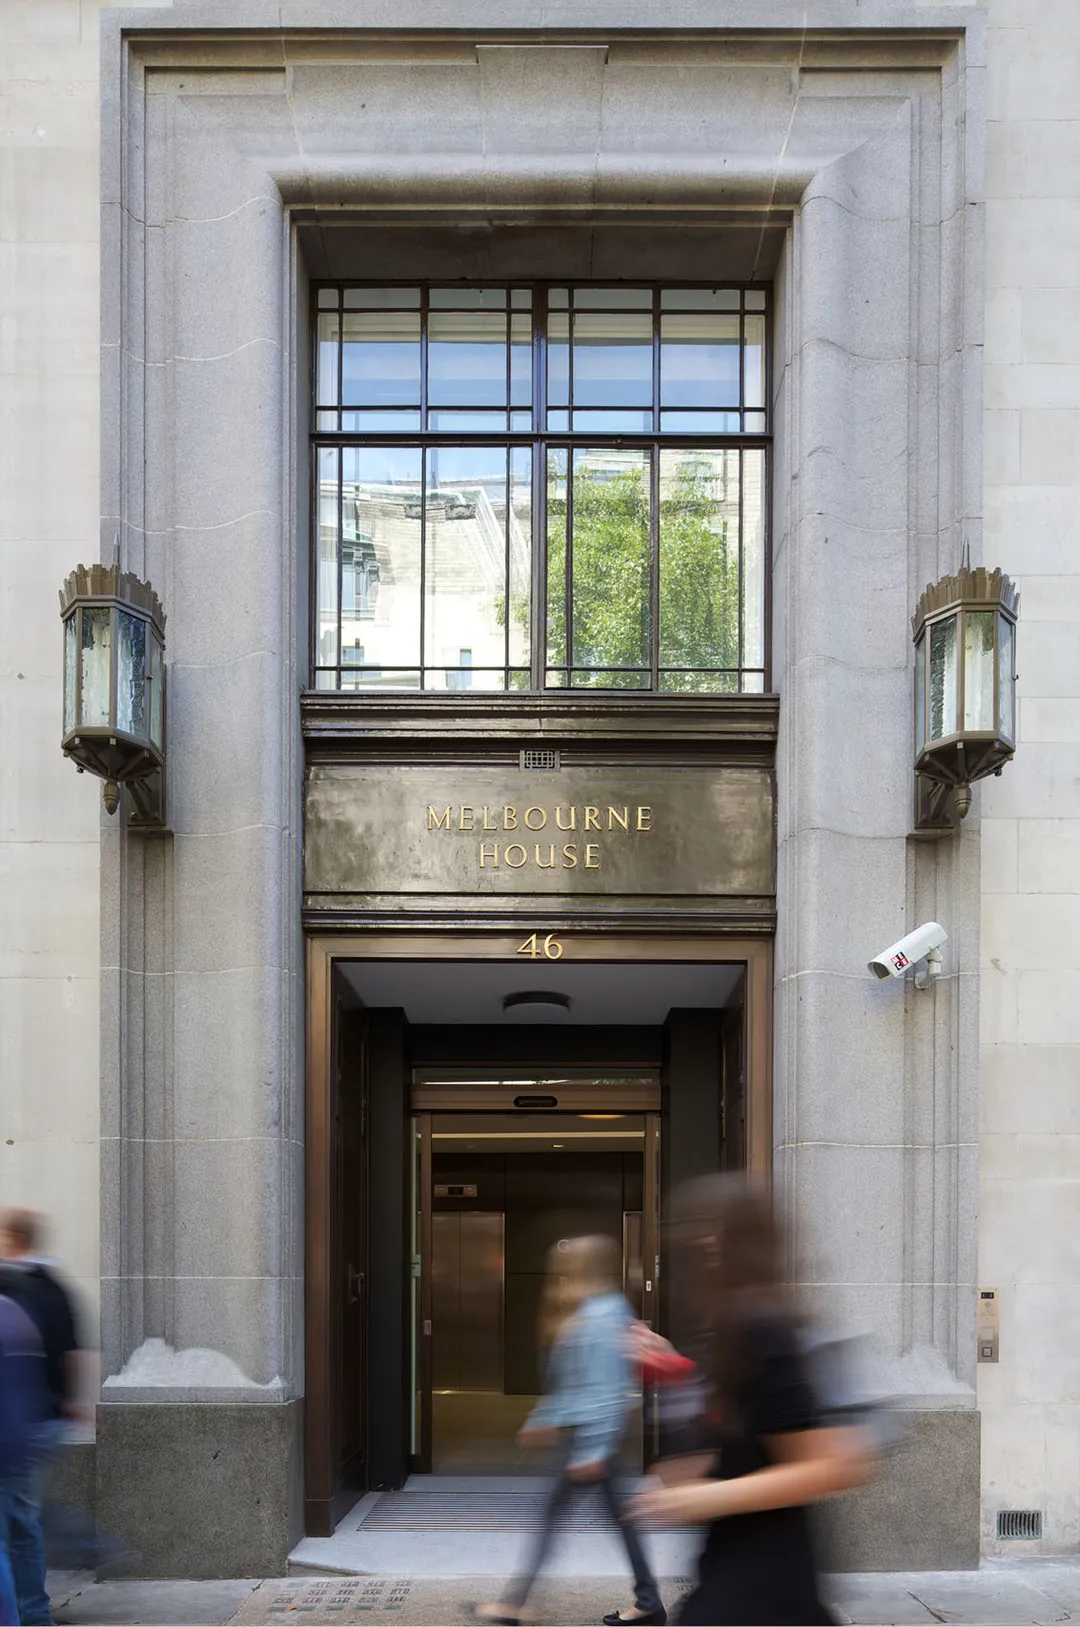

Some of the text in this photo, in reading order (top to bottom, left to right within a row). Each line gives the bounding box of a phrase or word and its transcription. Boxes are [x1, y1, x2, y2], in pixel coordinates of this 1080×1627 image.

[426, 805, 652, 832] MELBOURNE
[478, 843, 602, 870] HOUSE
[516, 932, 564, 960] 46
